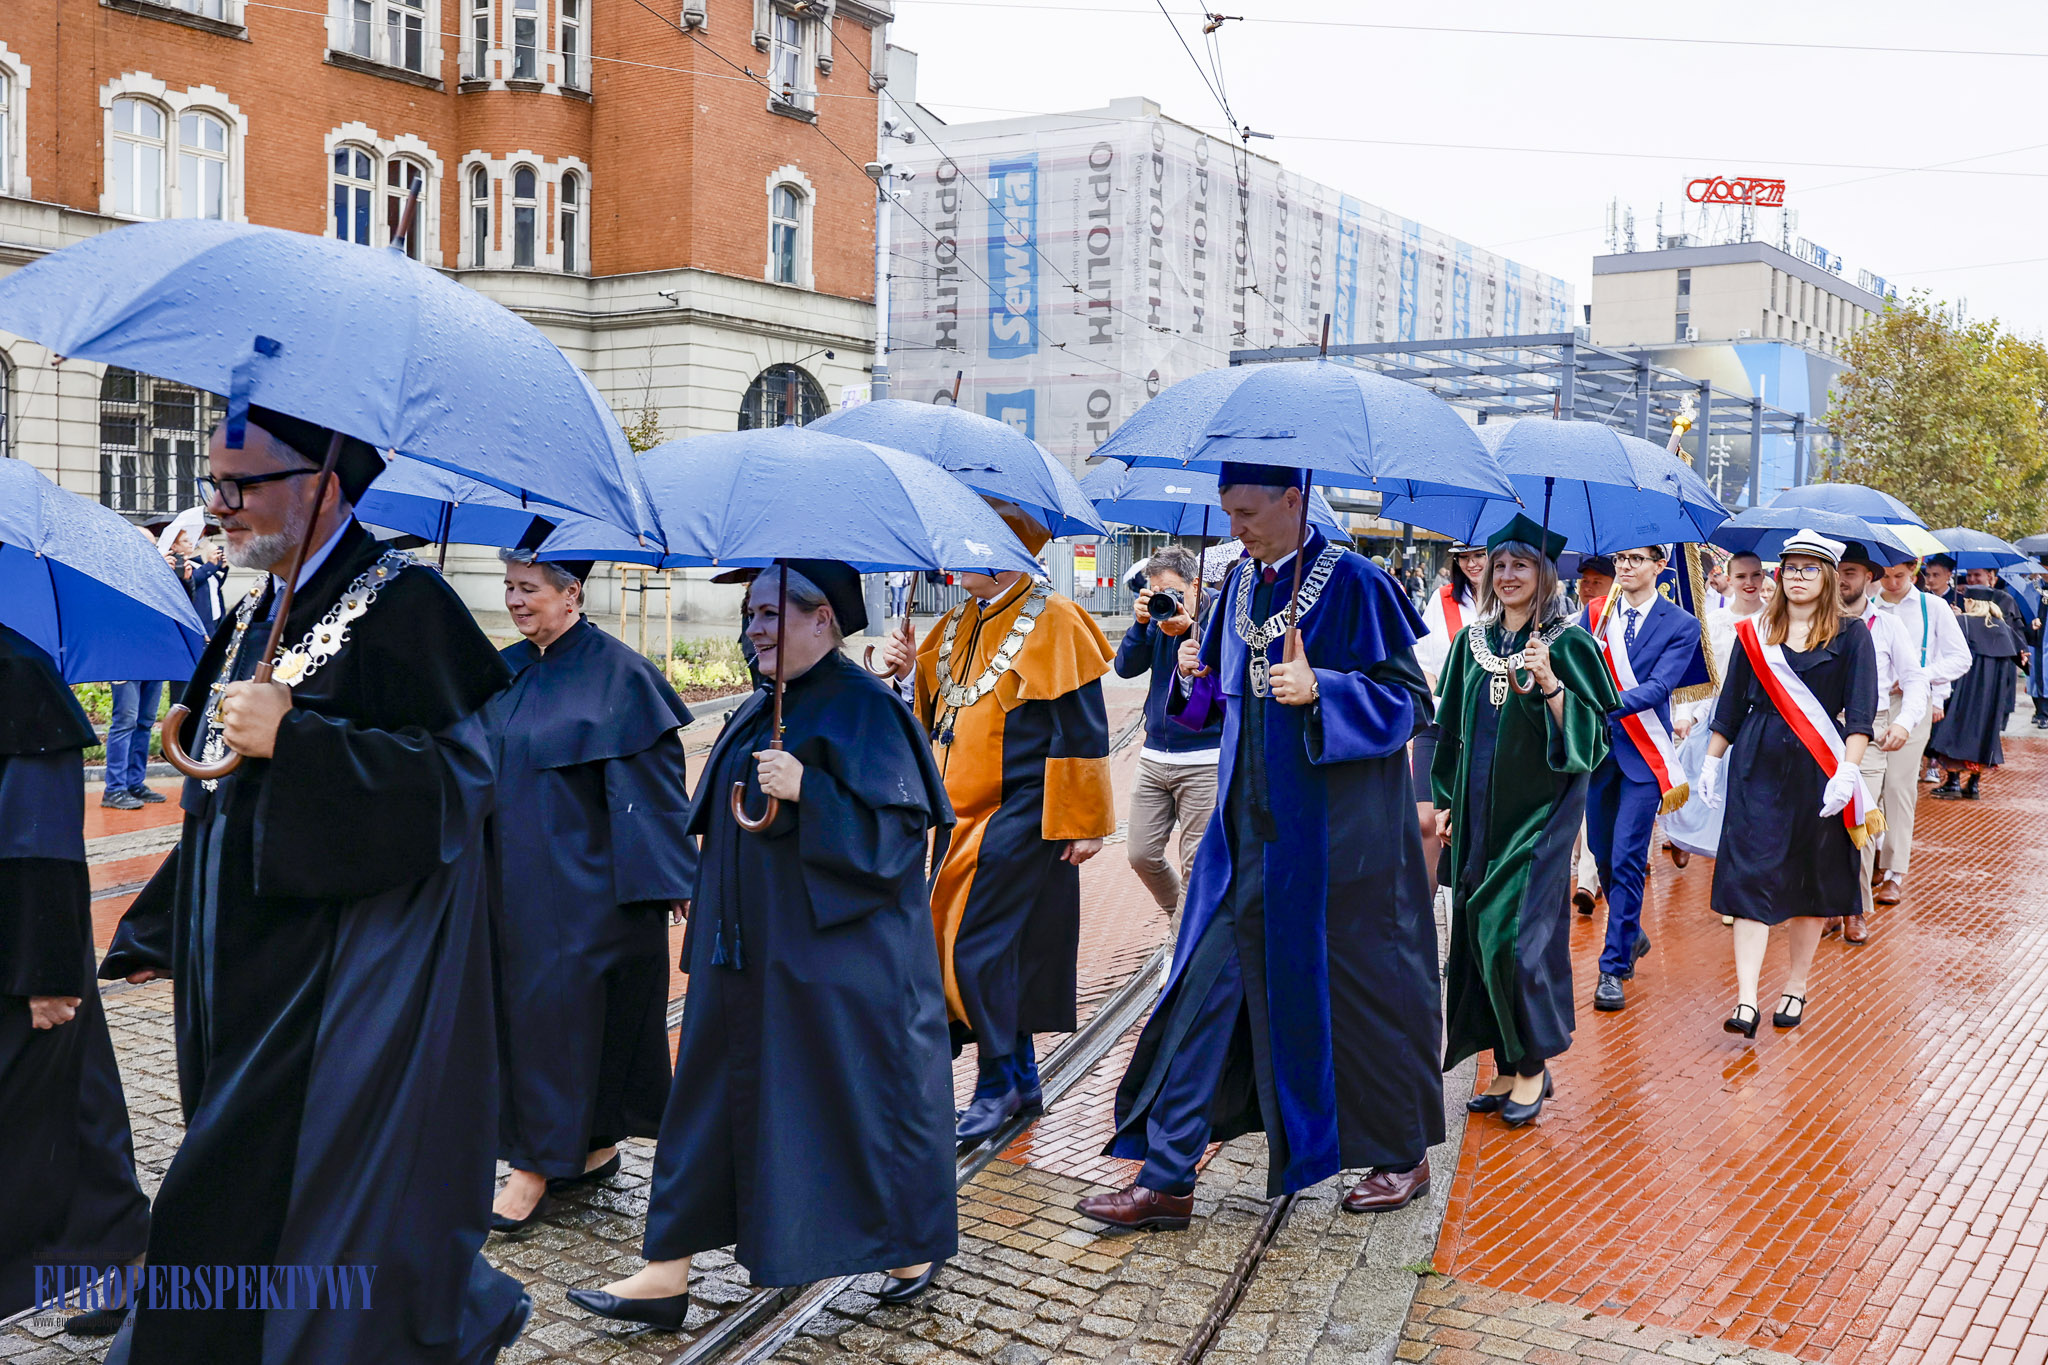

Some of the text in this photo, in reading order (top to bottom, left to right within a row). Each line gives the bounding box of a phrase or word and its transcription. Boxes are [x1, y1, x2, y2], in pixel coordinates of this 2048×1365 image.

[935, 157, 959, 349] OPTOLITH
[992, 172, 1031, 345] Sewera
[1087, 142, 1114, 346] OPTOLITH
[1147, 120, 1165, 325] OPTOLITH
[1192, 136, 1209, 334] OPTOLITH
